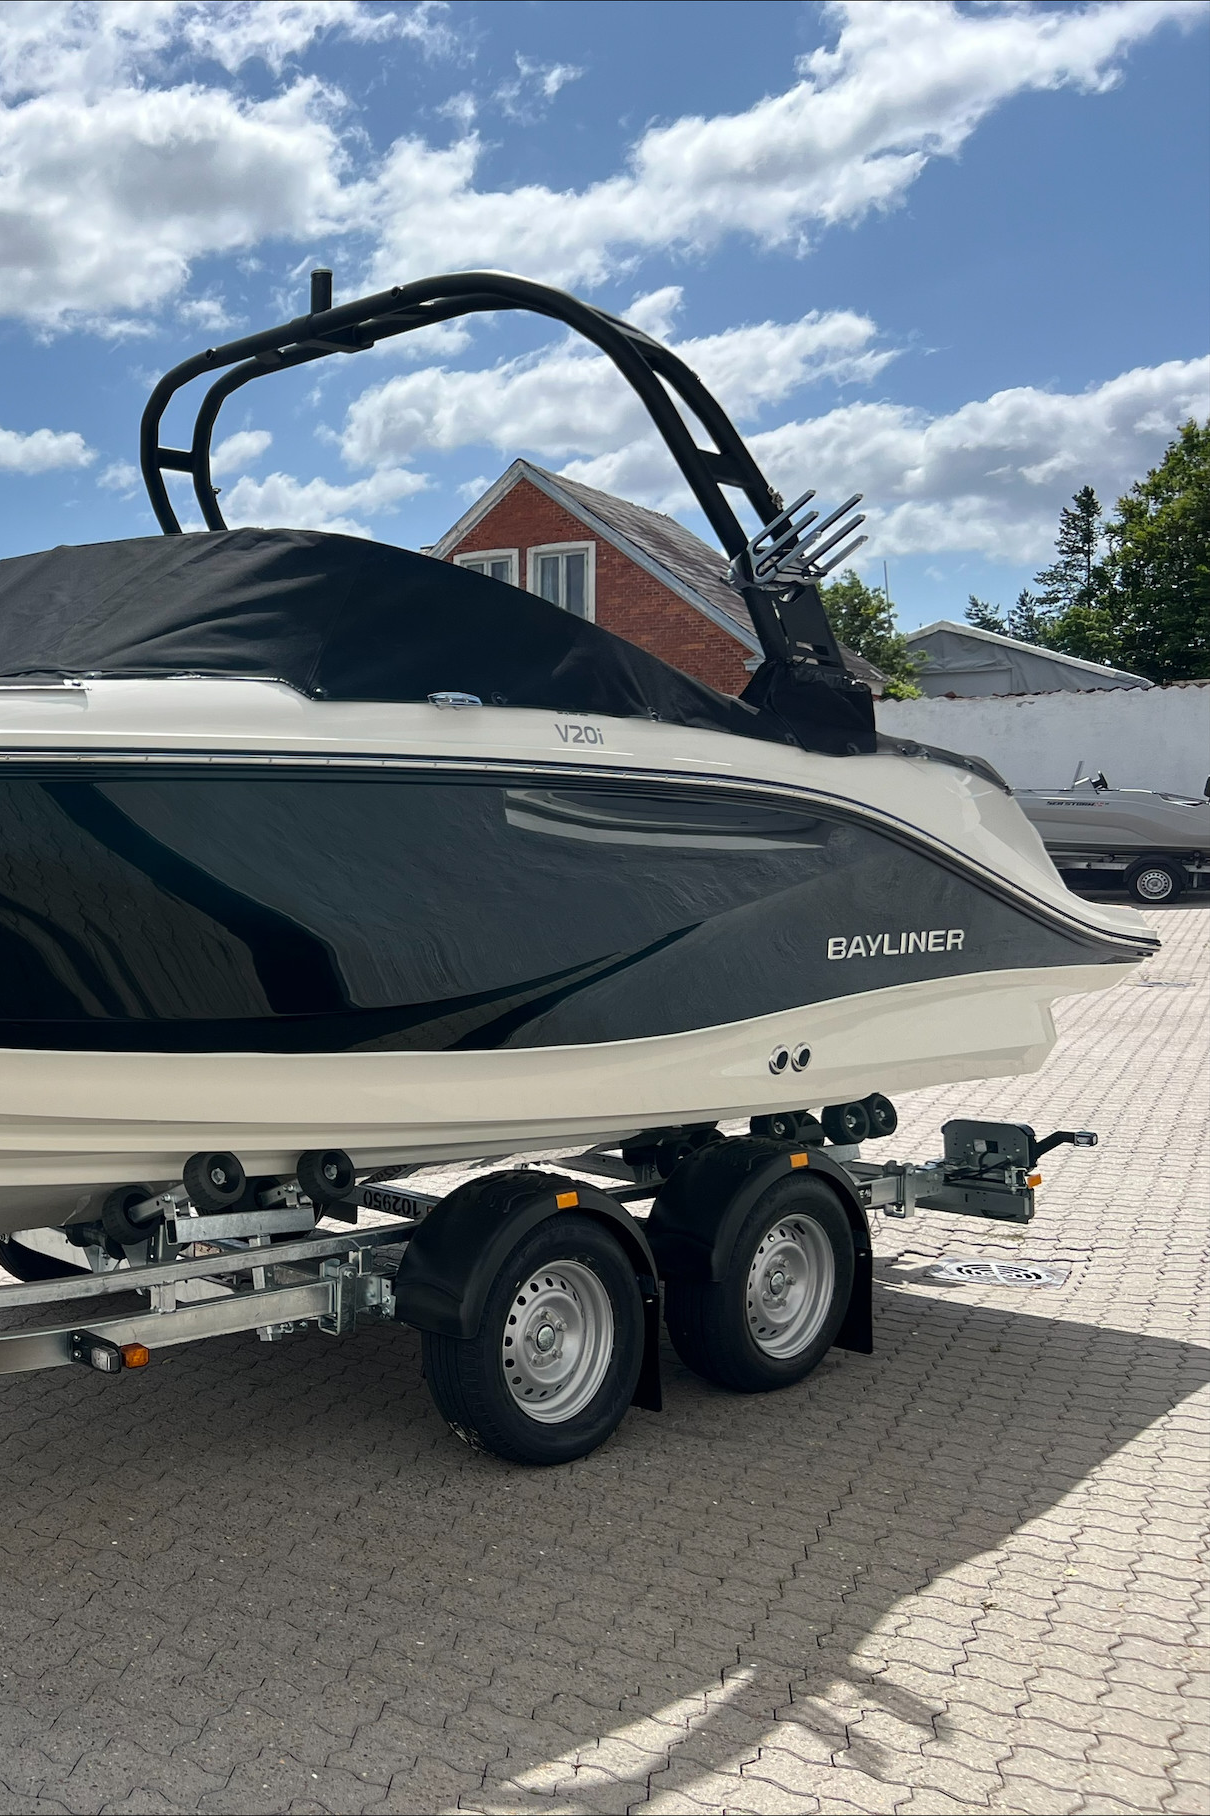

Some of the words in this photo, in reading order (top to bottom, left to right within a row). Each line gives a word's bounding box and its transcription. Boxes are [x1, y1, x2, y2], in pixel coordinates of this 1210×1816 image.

[554, 723, 604, 745] V20i
[827, 929, 965, 960] BAYLINER
[363, 1190, 421, 1216] 102950
